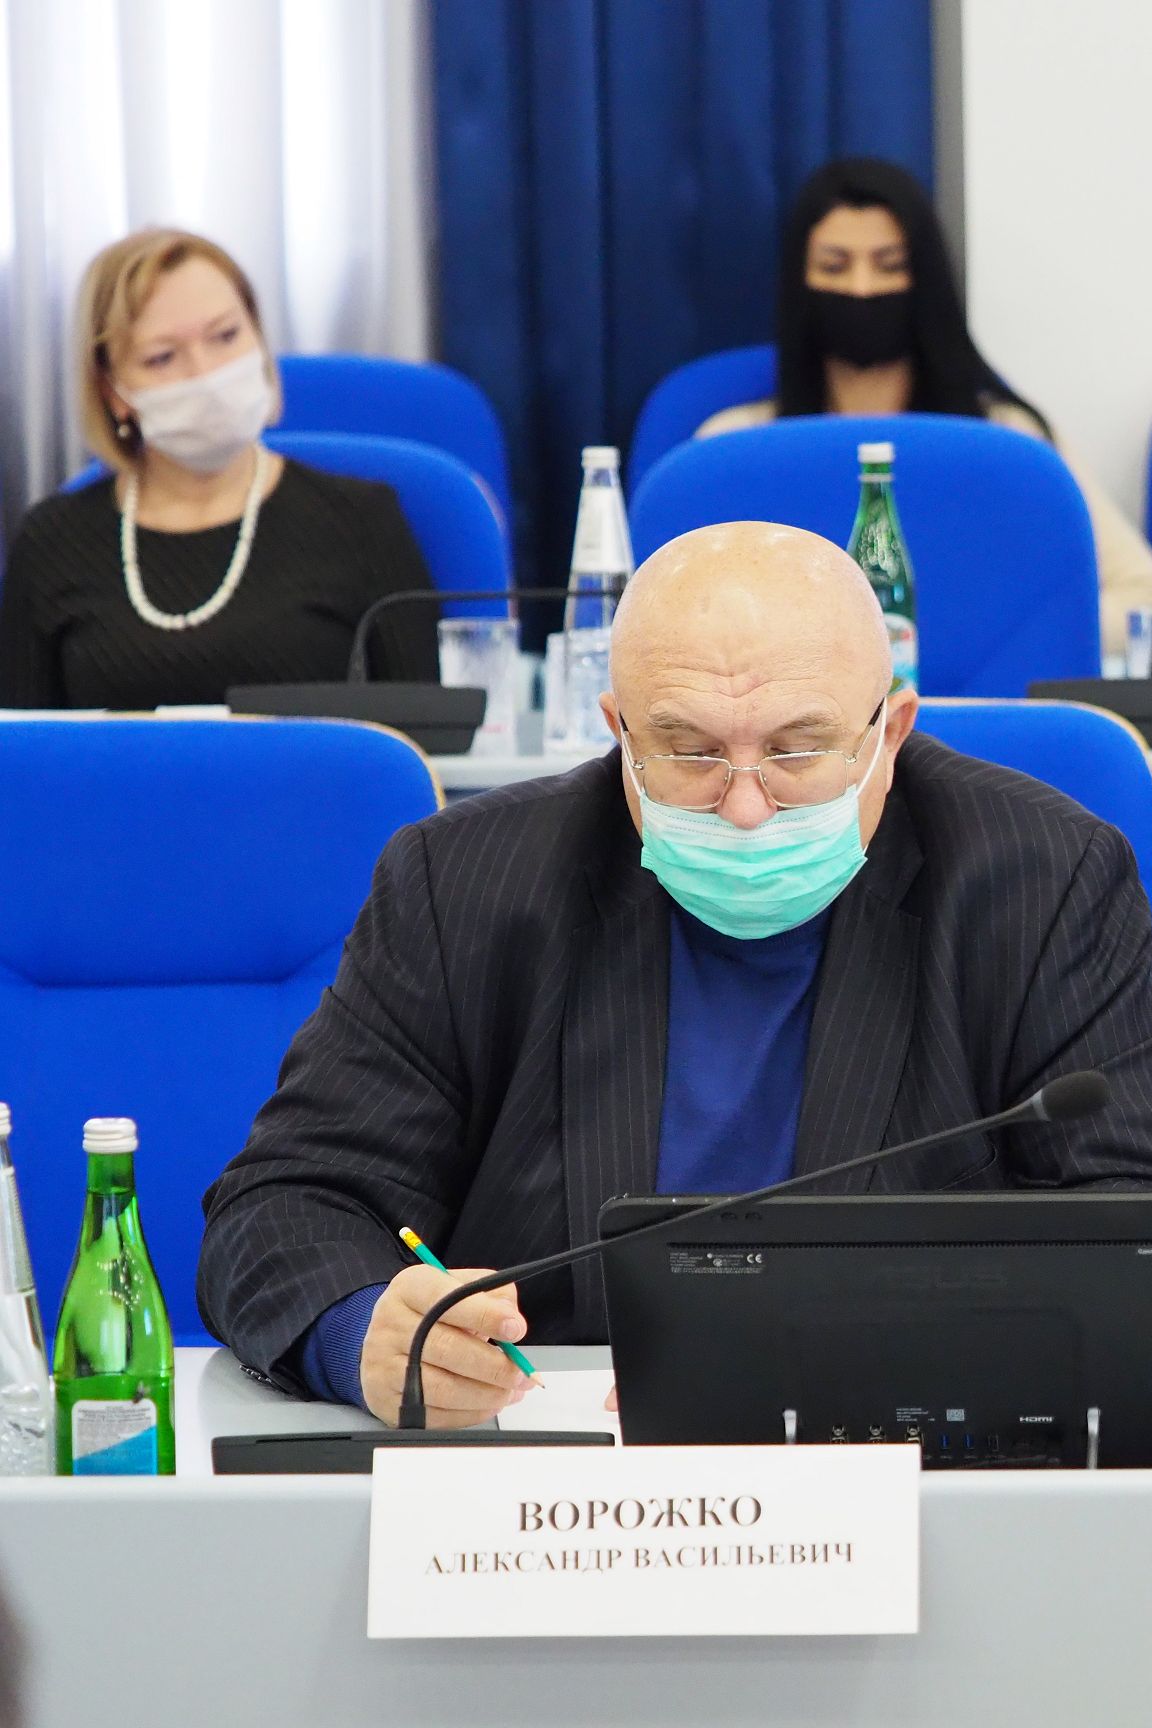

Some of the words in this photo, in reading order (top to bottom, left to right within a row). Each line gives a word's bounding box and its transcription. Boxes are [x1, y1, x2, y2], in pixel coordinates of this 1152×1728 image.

[519, 1496, 761, 1532] ВОРОЖКО
[426, 1549, 622, 1574] АЛЕКСАНДР
[634, 1543, 852, 1568] ВАСИЛЬЕВИЧ
